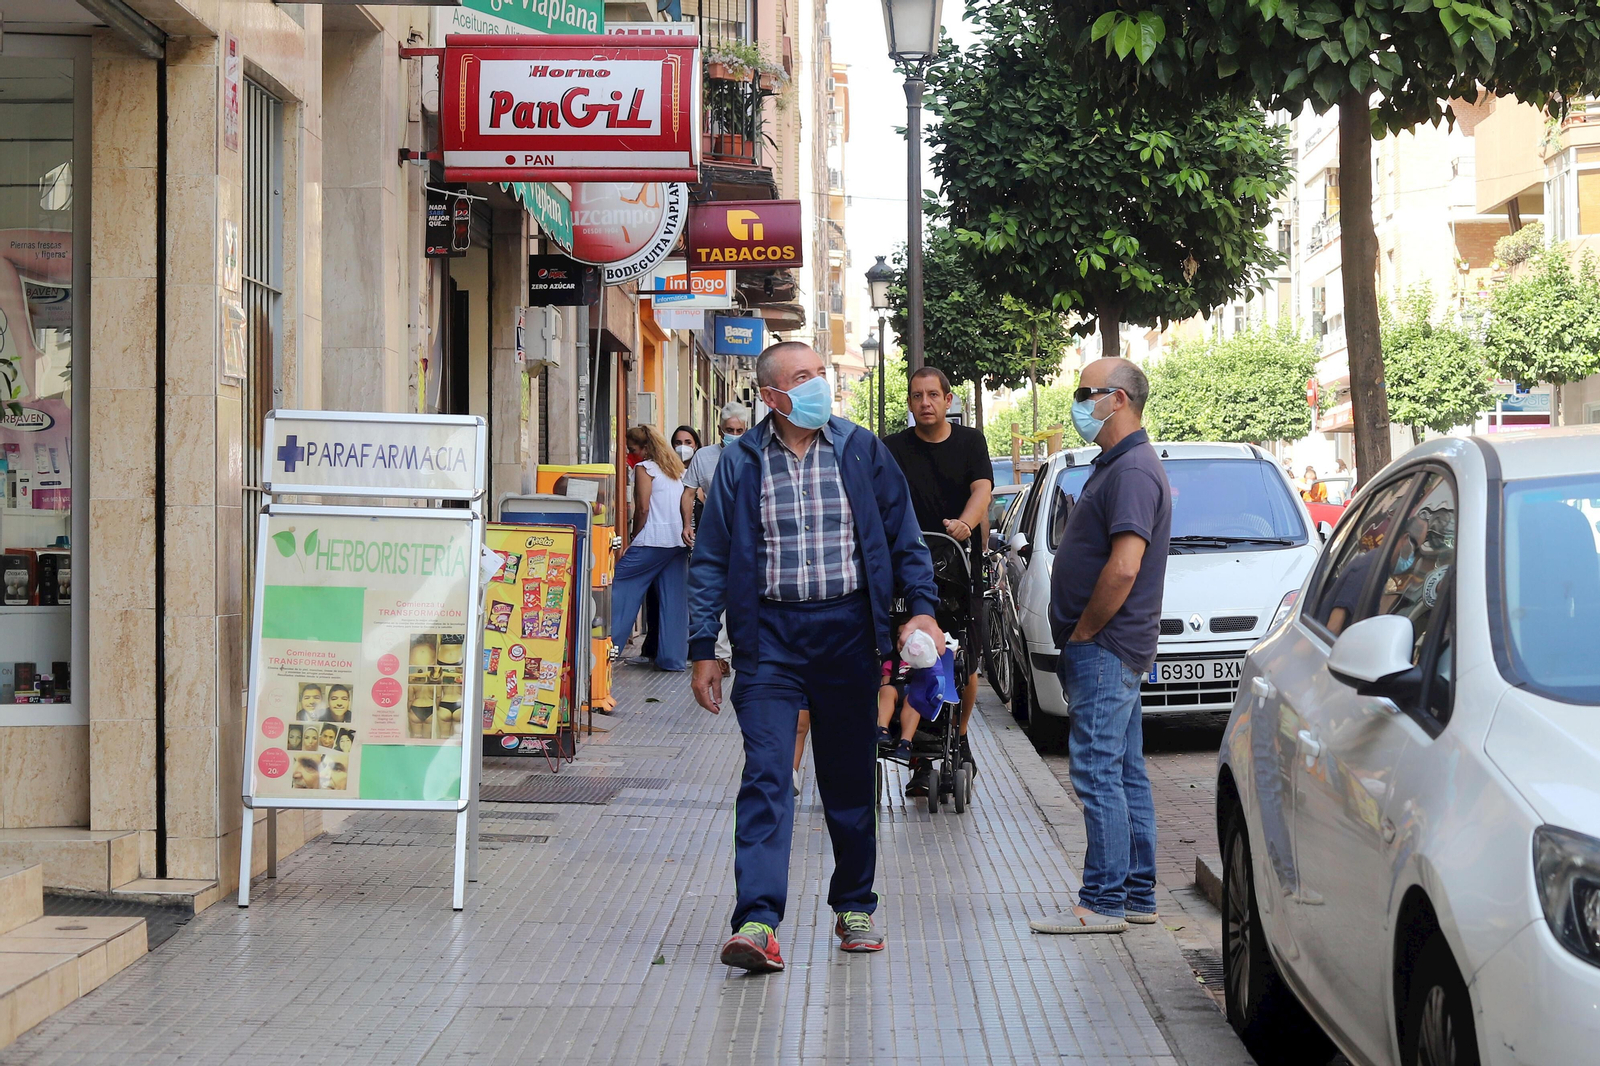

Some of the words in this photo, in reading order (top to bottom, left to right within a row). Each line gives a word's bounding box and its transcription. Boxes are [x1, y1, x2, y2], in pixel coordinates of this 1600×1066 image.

[529, 65, 611, 78] Horno
[524, 154, 555, 166] PAN
[10, 241, 36, 250] Piernas
[37, 241, 62, 250] frescas
[606, 238, 671, 280] BODEGUITA
[697, 246, 796, 263] TABACOS
[549, 281, 576, 290] AZÚCAR
[656, 294, 688, 303] informática
[724, 325, 754, 338] Bazar
[306, 441, 468, 473] PARAFARMACIA
[525, 536, 555, 549] Cheetos
[315, 536, 468, 577] HERBORISTERÍA
[395, 600, 435, 609] Comienza
[437, 601, 446, 609] tu
[378, 607, 462, 618] TRANSFORMACIÓN
[286, 648, 327, 659] Comienza
[327, 649, 337, 659] tu
[268, 657, 354, 669] TRANSFORMACIÓN
[1161, 663, 1205, 680] 6930
